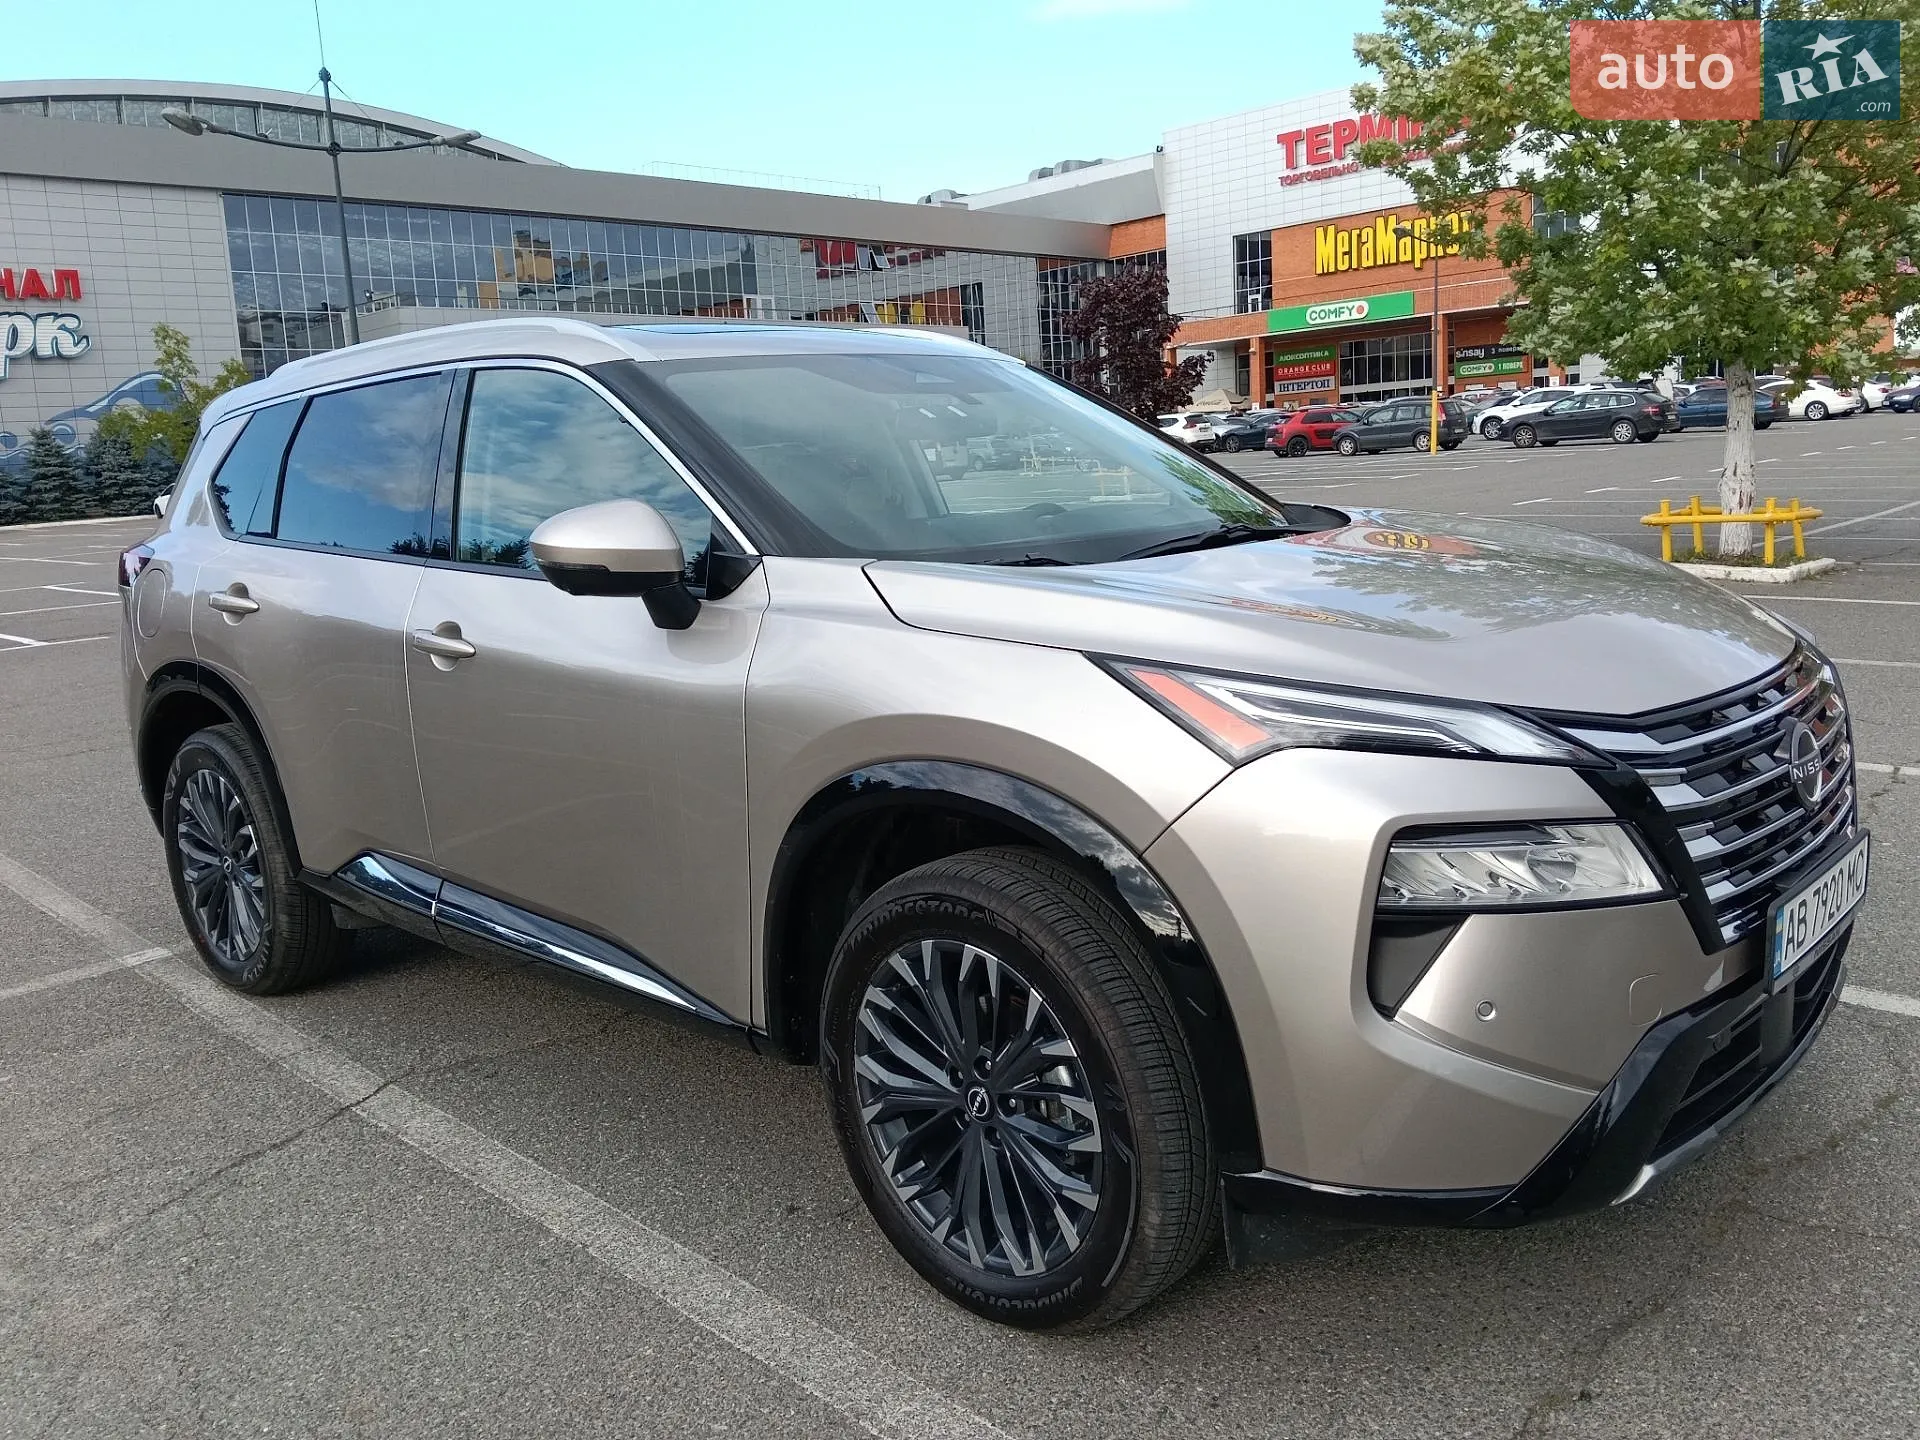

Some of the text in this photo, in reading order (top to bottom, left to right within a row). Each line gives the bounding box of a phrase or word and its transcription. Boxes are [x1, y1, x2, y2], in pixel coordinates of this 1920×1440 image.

[1309, 305, 1355, 322] COMFY
[1455, 348, 1485, 358] sinsay
[1278, 365, 1310, 374] ORANGE
[1311, 363, 1330, 371] CLUB
[1461, 365, 1487, 373] COMFY
[1793, 759, 1820, 779] NISS
[1784, 899, 1808, 961] AB
[1812, 867, 1845, 937] 7920
